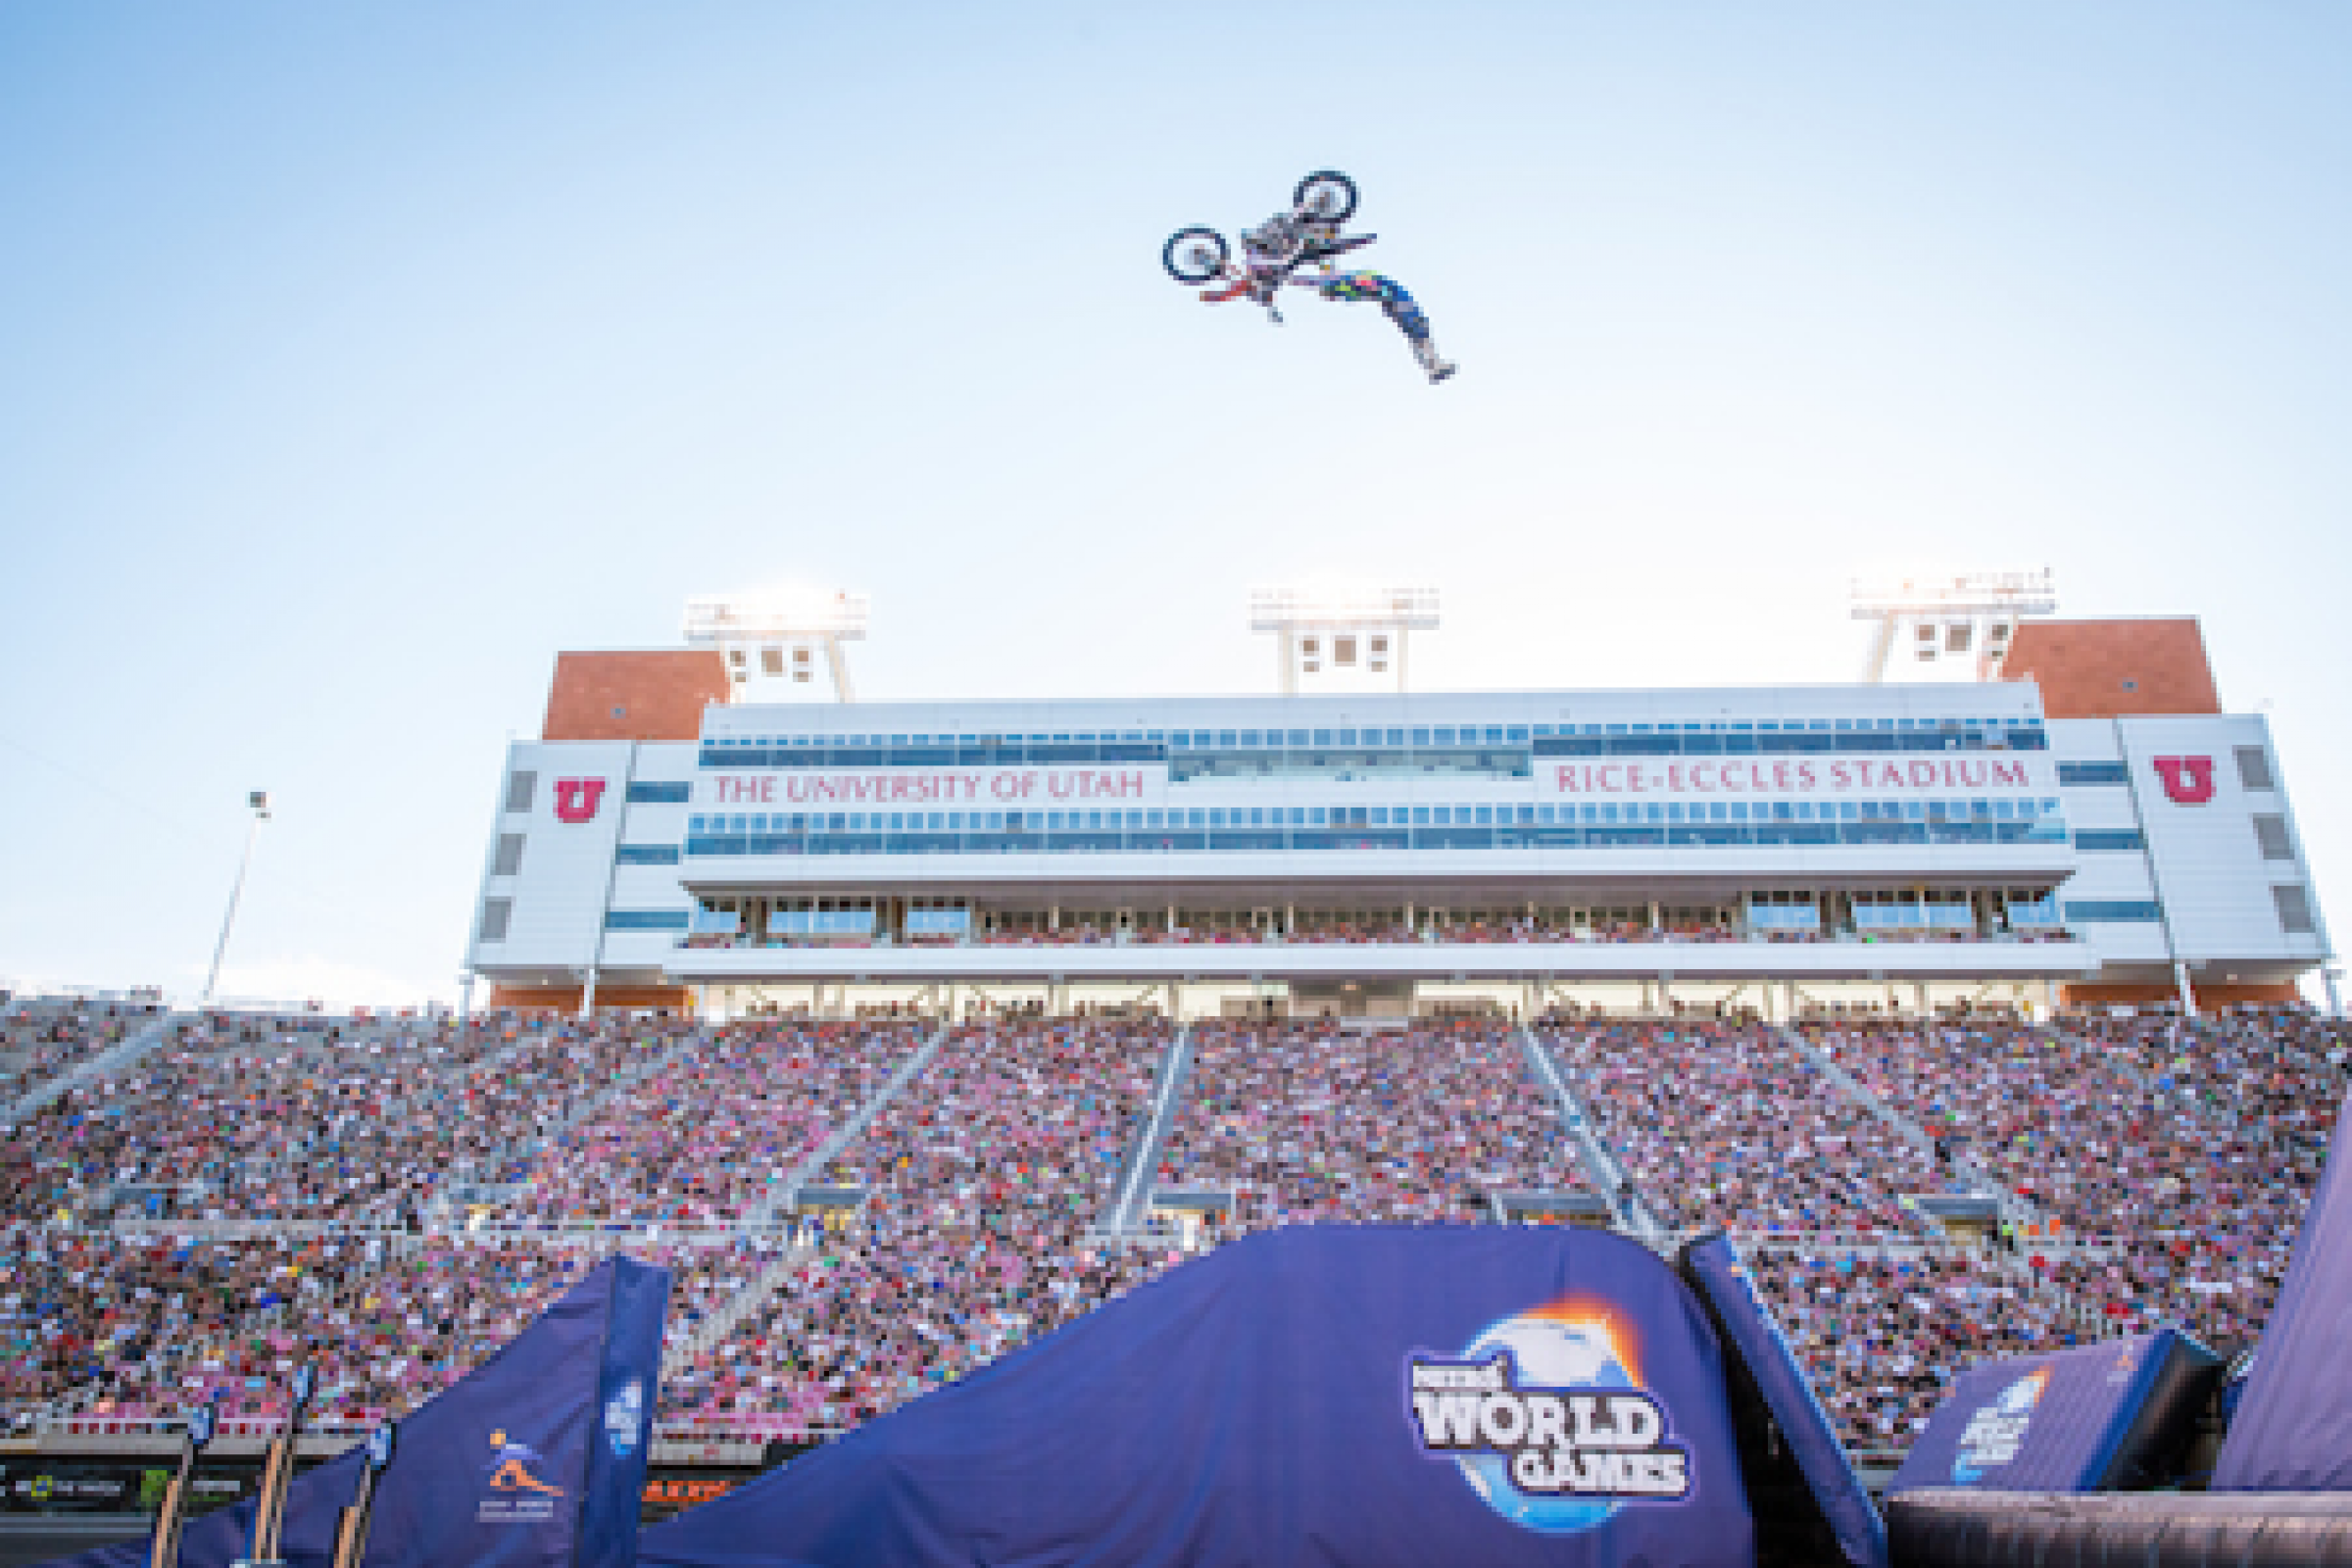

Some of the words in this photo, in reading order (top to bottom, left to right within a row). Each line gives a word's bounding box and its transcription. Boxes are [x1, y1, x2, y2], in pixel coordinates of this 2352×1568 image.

[713, 775, 778, 803] THE
[786, 773, 980, 804] UNIVERSITY
[990, 771, 1039, 802] OF
[1047, 769, 1145, 800] UTAH
[1829, 759, 2031, 788] STADIUM
[2153, 756, 2215, 806] U
[553, 776, 606, 823] U
[1411, 1388, 1662, 1450] WORLD
[1511, 1448, 1688, 1494] GAMES
